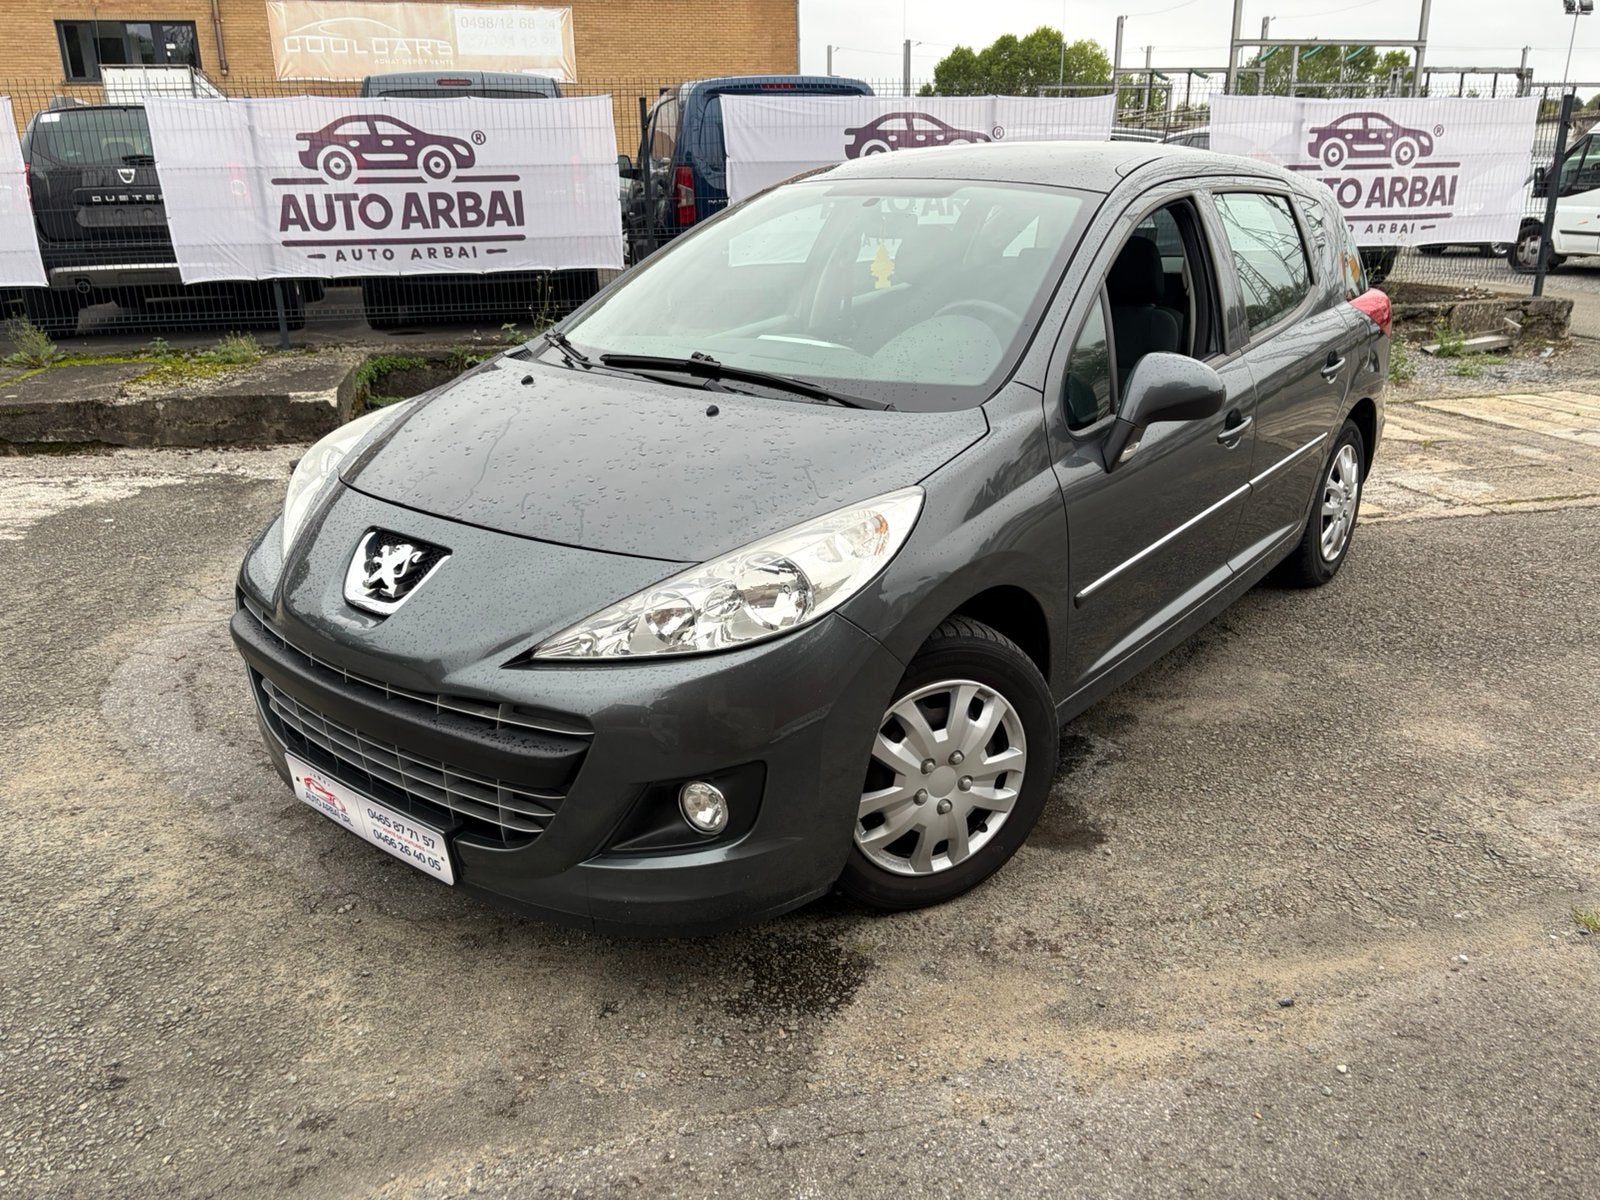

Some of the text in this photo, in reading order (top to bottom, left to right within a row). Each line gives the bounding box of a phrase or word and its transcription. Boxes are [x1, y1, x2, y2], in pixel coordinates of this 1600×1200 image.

[460, 16, 514, 29] 0498/12
[519, 17, 536, 30] 68
[1365, 175, 1458, 208] ARBAI
[279, 190, 525, 232] AUTO ARBAI
[1364, 223, 1416, 235] ARBAI
[335, 246, 478, 262] AUTO ARBAI
[367, 808, 391, 828] 0465
[392, 821, 405, 834] 87
[407, 828, 420, 842] 71
[422, 835, 435, 849] 57
[373, 829, 397, 849] 0466
[397, 842, 411, 857] 26
[413, 851, 426, 864] 40
[427, 857, 441, 872] 05
